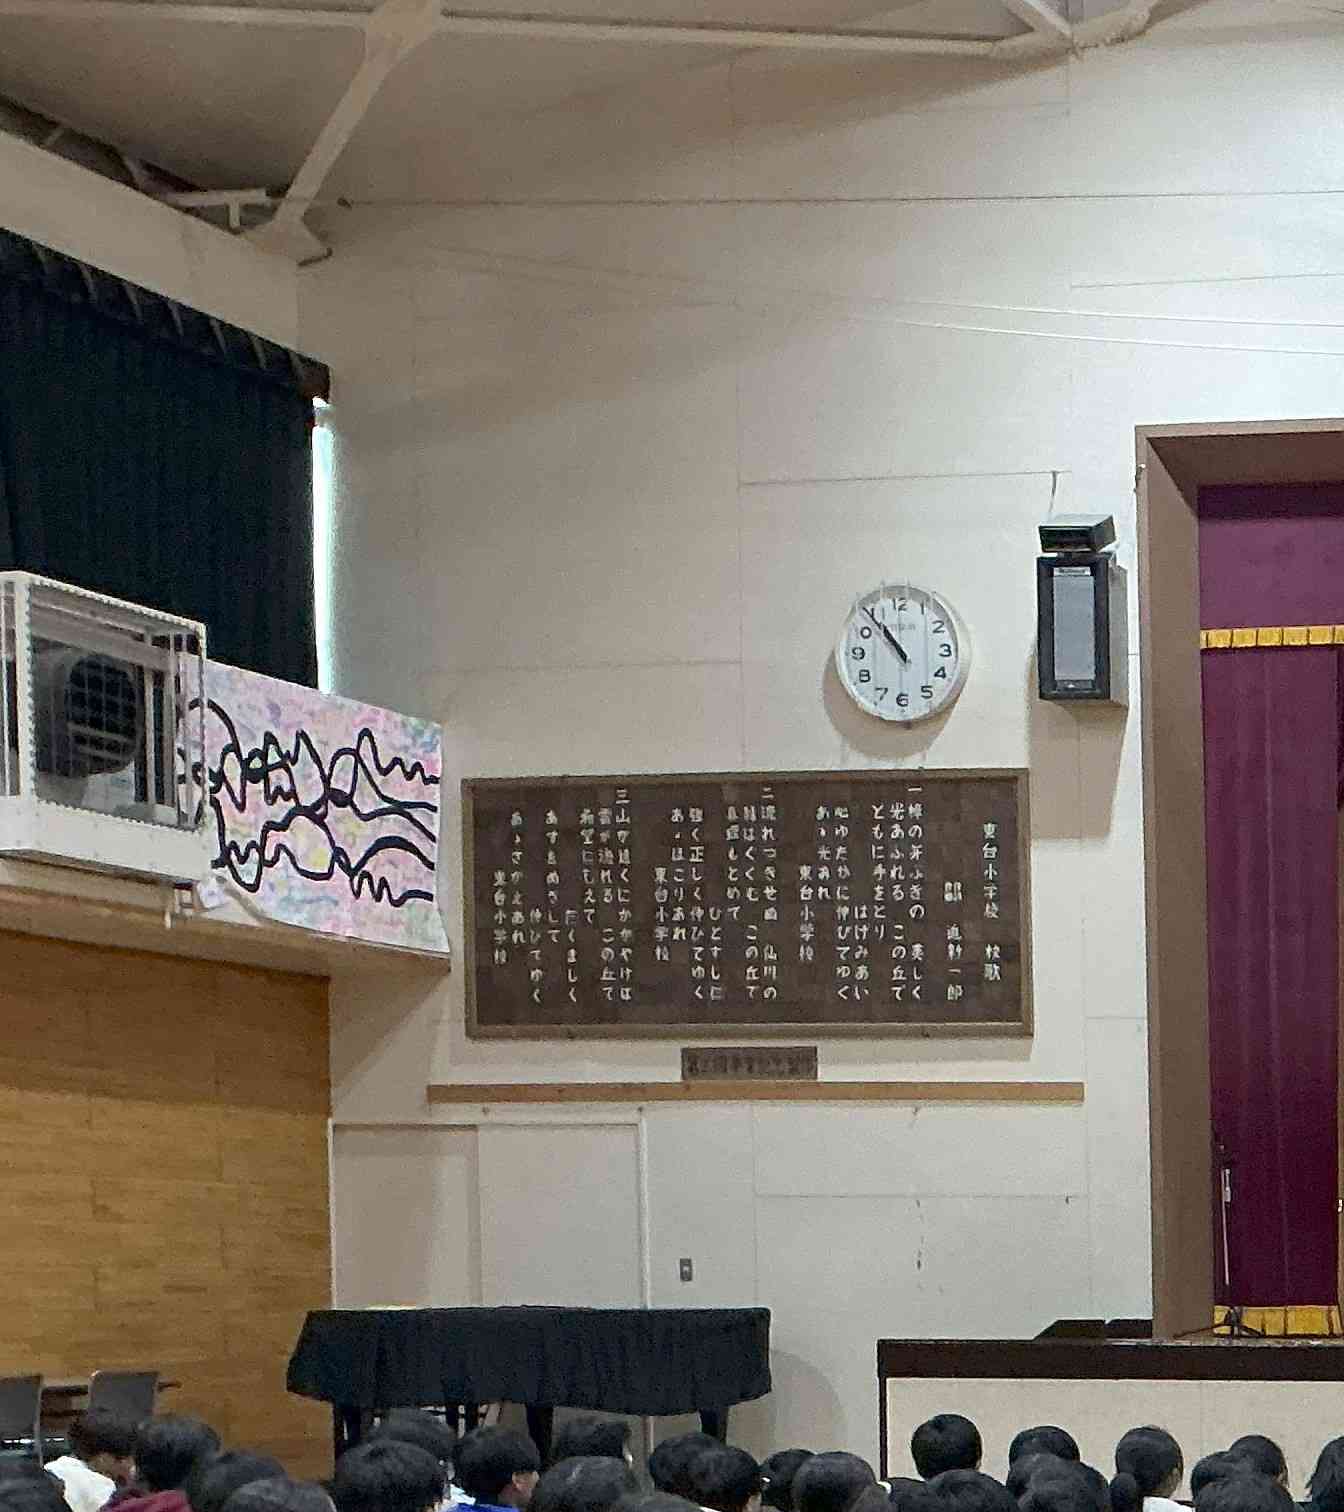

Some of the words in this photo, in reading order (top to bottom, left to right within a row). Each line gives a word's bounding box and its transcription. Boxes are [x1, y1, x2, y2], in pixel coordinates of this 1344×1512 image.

[892, 598, 908, 611] 12
[920, 603, 925, 615] 1
[933, 621, 945, 634] 2
[852, 647, 866, 660] 9
[939, 644, 952, 657] 3
[859, 670, 871, 683] 8
[934, 666, 947, 679] 4
[876, 687, 888, 701] 7
[921, 685, 933, 699] 5
[896, 693, 909, 707] 6
